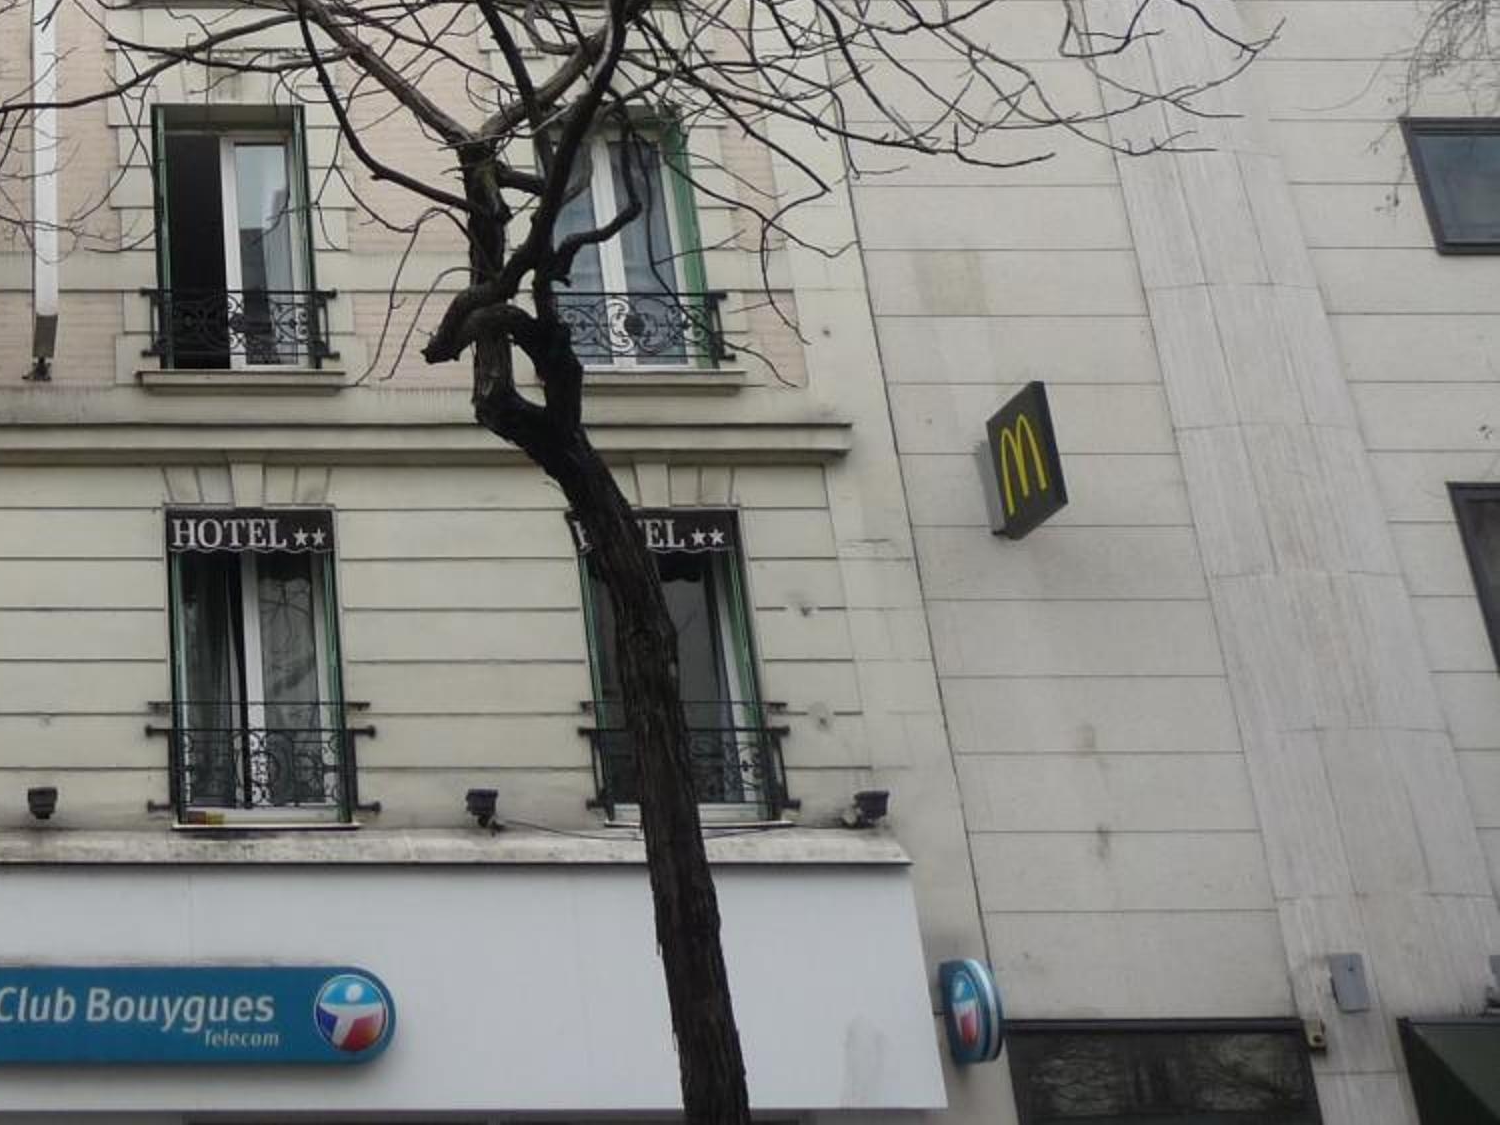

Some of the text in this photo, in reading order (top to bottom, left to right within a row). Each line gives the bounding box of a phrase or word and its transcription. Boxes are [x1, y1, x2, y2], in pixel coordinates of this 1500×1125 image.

[171, 517, 287, 549] HOTEL
[85, 985, 275, 1033] Bouygues
[204, 1030, 280, 1048] Telecom
